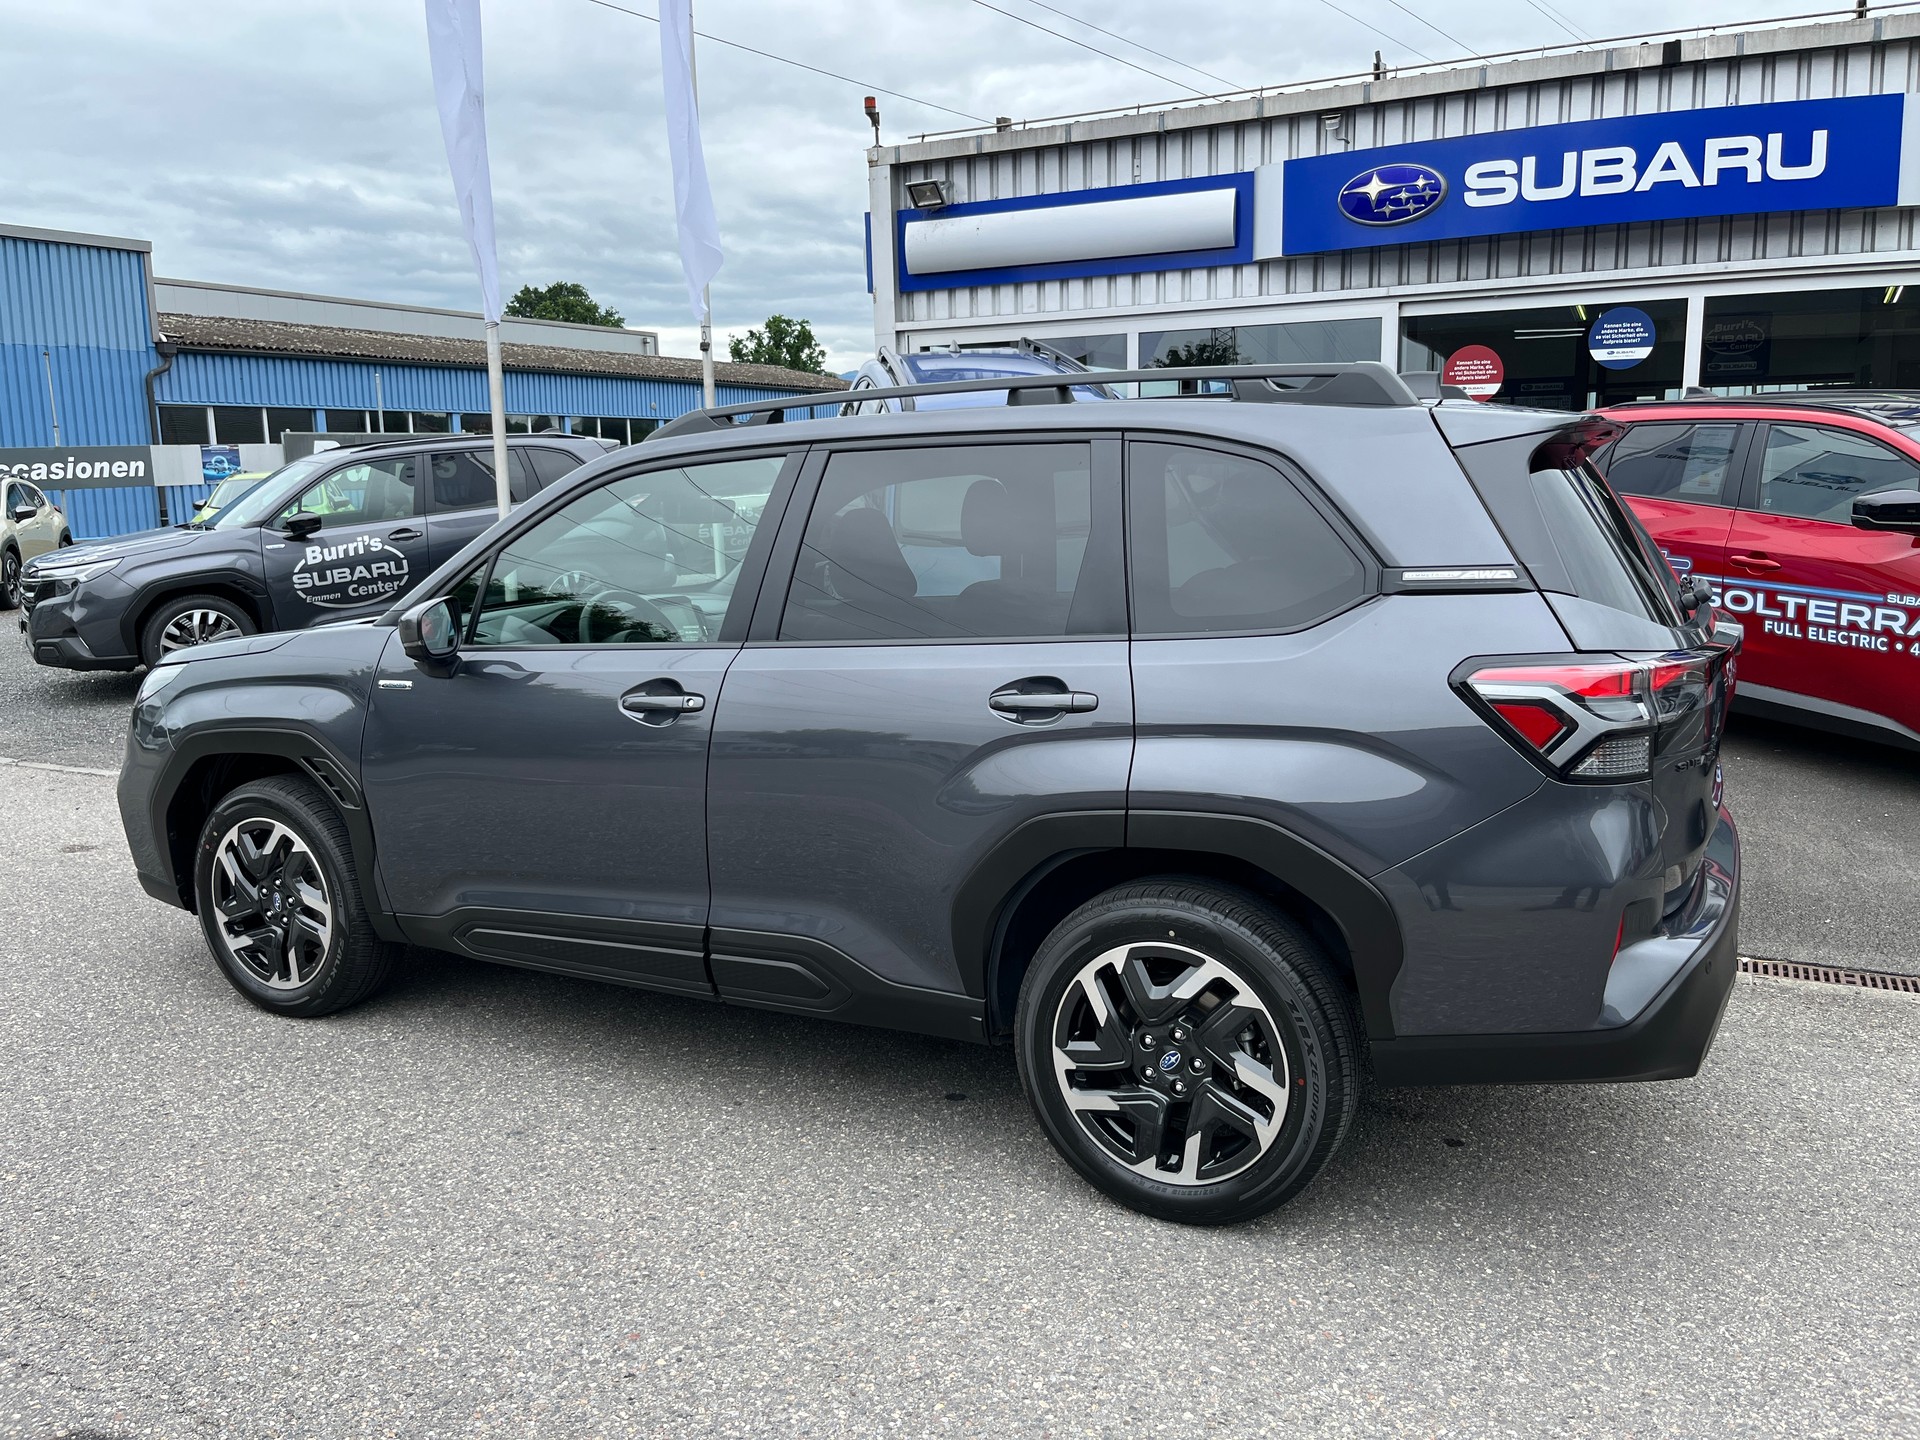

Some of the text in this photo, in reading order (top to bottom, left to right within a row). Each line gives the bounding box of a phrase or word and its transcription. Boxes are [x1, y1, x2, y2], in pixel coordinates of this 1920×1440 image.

[1463, 130, 1827, 207] SUBARU
[1705, 333, 1764, 343] SUBARU
[305, 535, 383, 565] Burri's
[292, 560, 409, 589] SUBARU
[306, 581, 399, 603] Emmen Center
[1764, 620, 1802, 638] FULL
[1808, 627, 1888, 651] ELECTRIC
